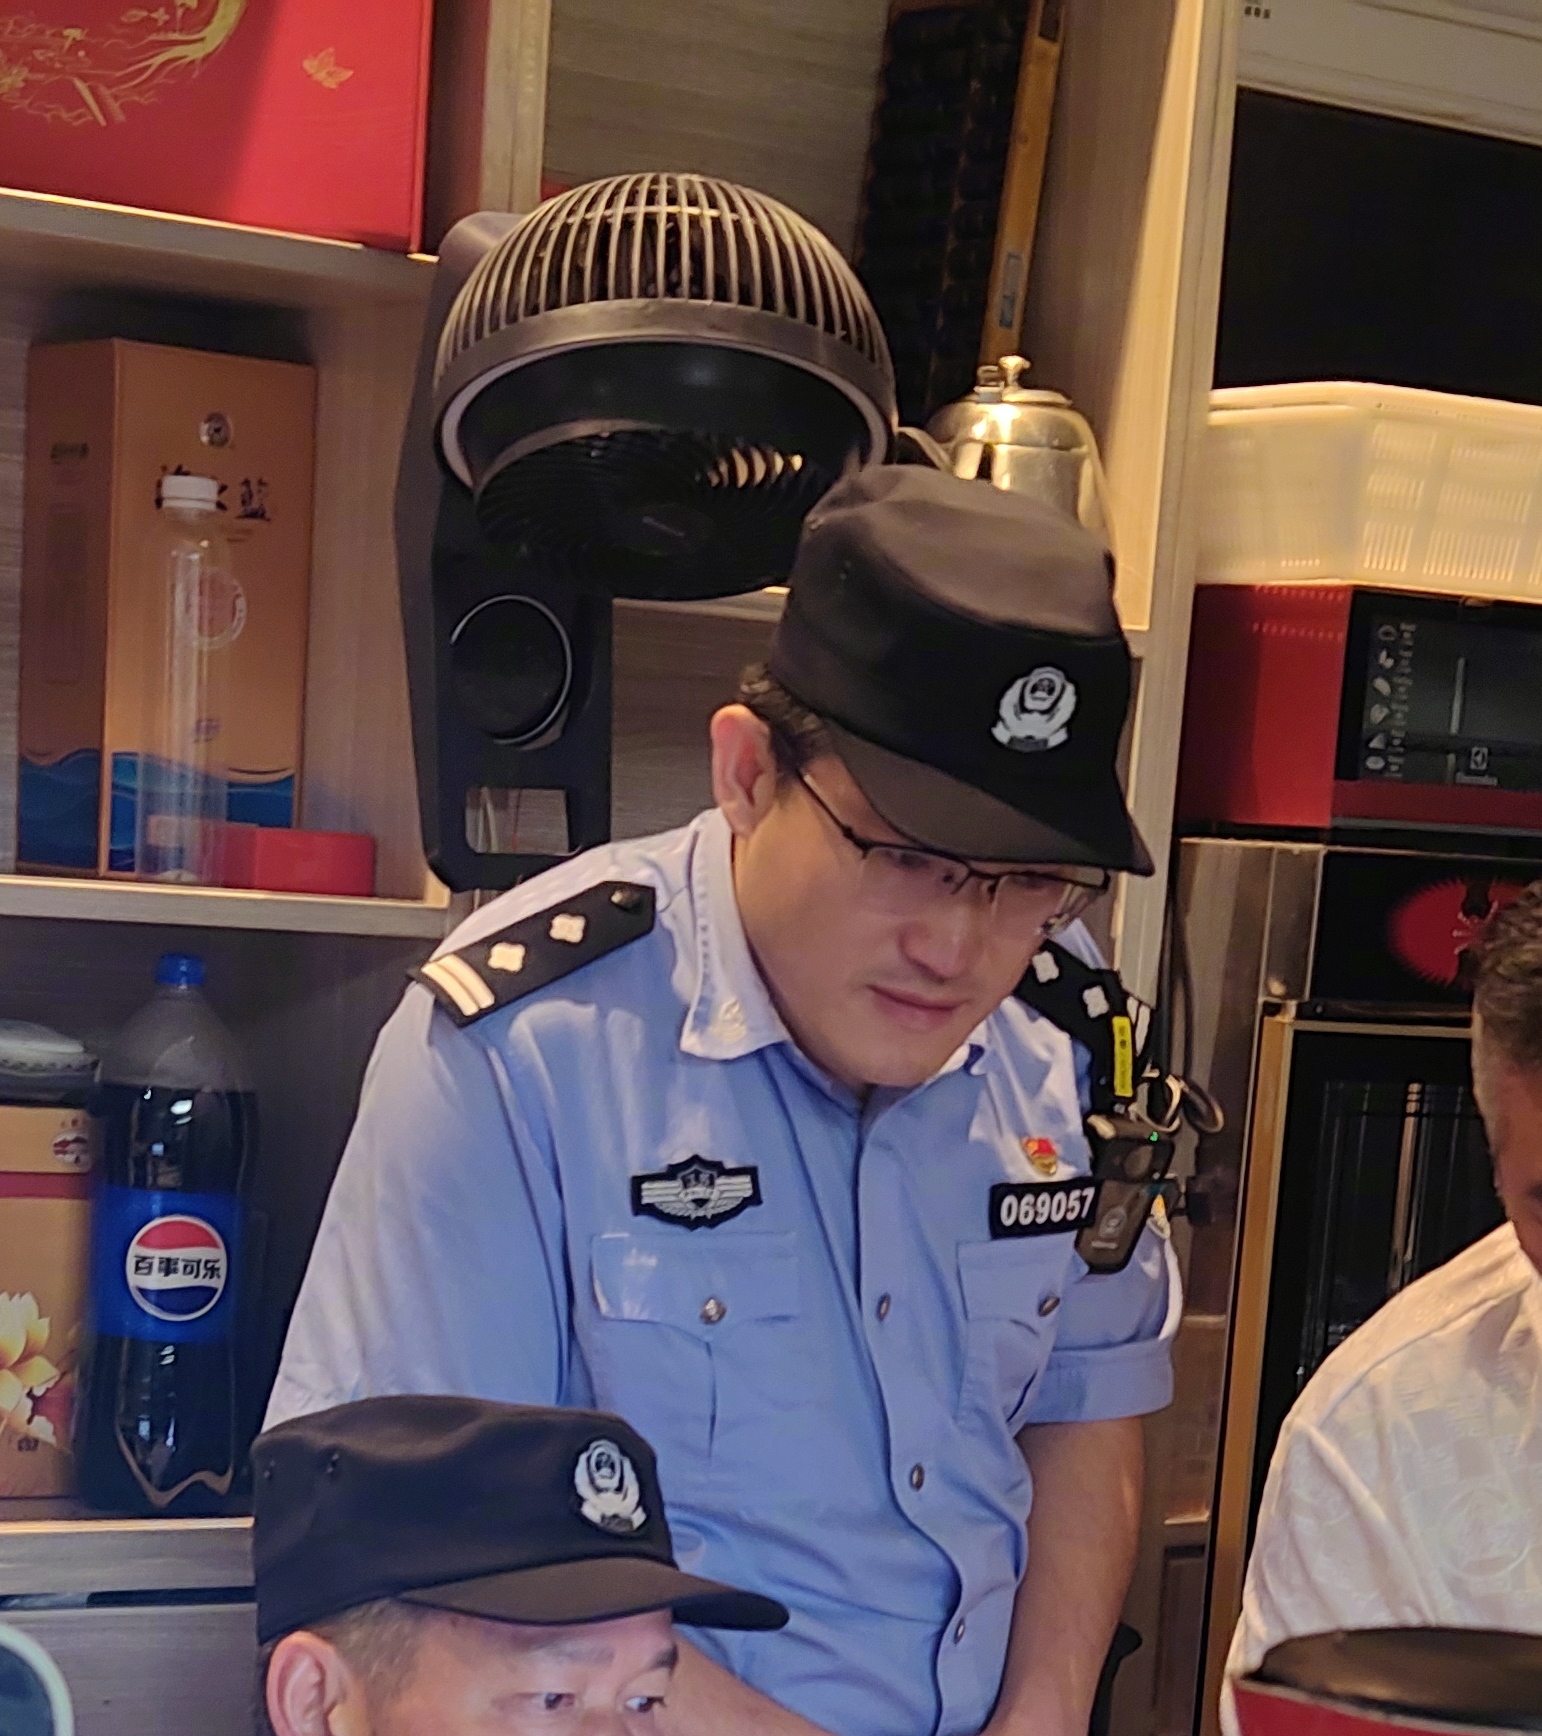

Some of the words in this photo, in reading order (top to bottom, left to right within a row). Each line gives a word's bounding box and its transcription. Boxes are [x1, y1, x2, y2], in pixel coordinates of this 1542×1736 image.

[1000, 1186, 1096, 1227] 069057
[133, 1254, 221, 1280] 百事可乐
